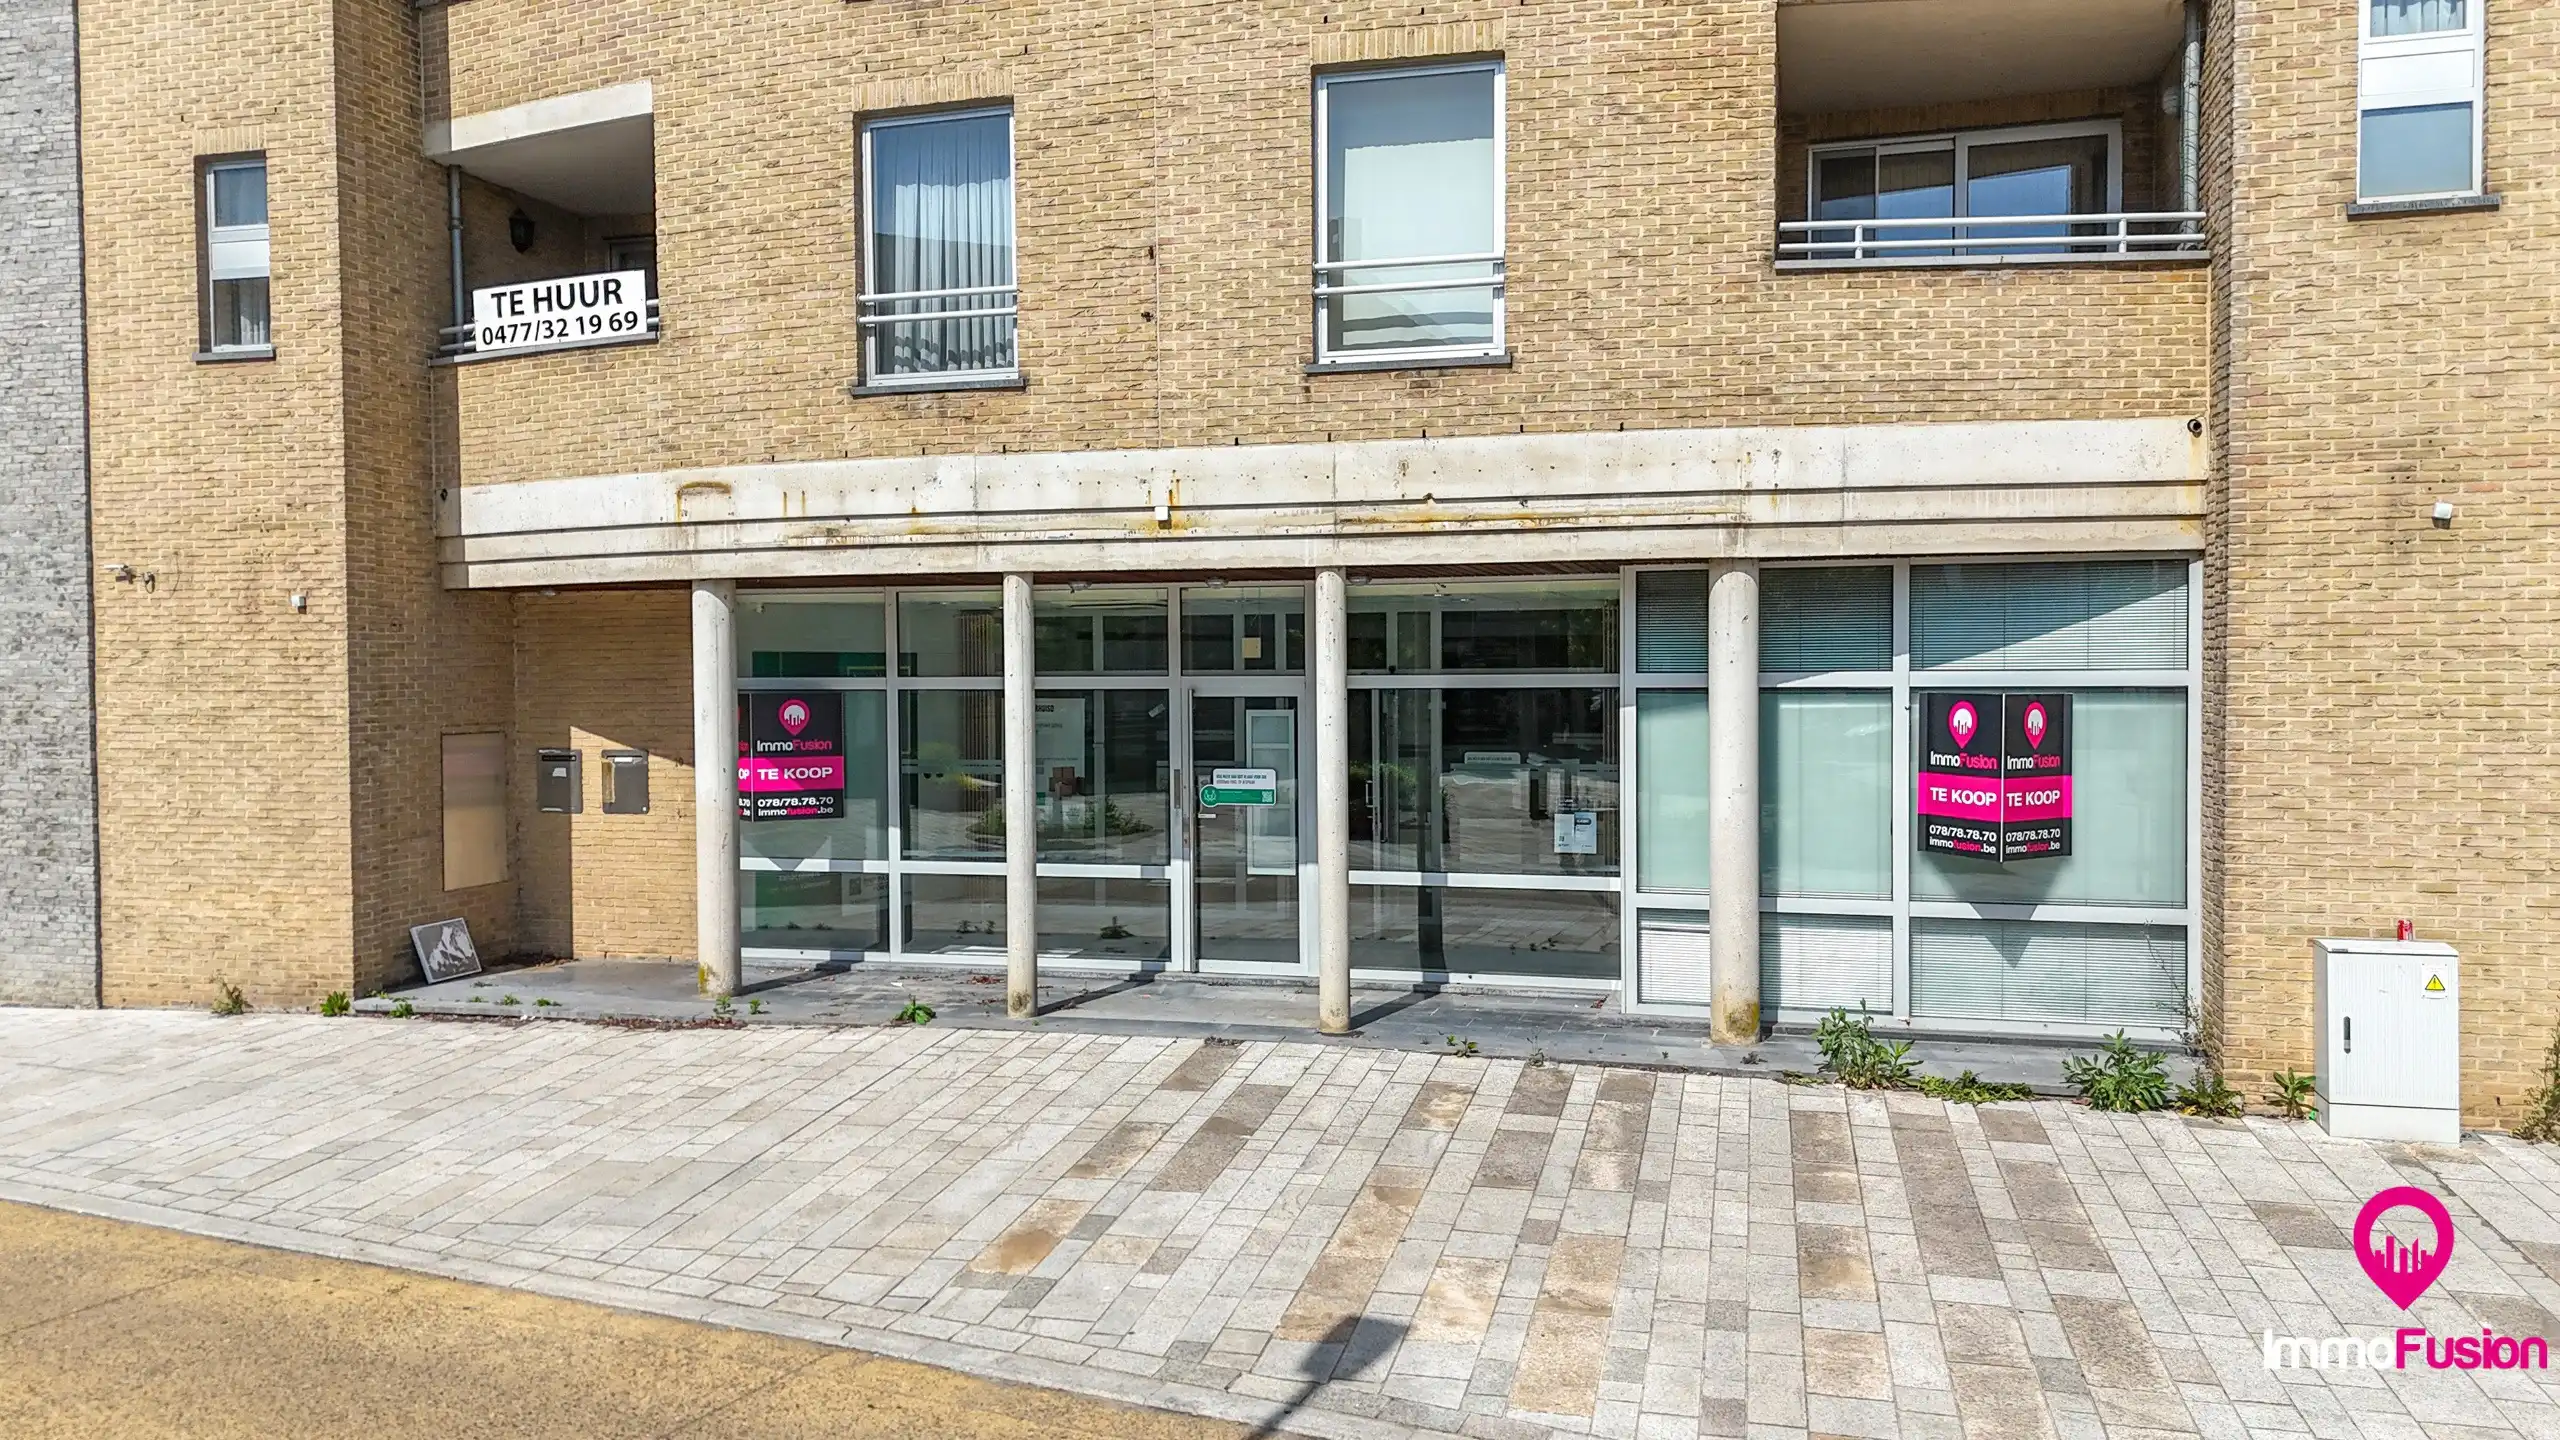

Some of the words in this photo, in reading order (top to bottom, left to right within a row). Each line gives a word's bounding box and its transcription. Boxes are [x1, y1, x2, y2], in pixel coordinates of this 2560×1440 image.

[491, 290, 524, 318] TE
[533, 279, 622, 314] HUUR
[482, 319, 569, 346] 0477/32
[575, 314, 602, 335] 19
[609, 310, 639, 332] 69
[756, 739, 832, 752] ImmoFusion
[1930, 751, 1998, 770] ImmoFusion
[2007, 754, 2061, 770] ImmoFusion
[757, 768, 779, 780] TE
[783, 767, 833, 779] KOOP
[757, 796, 834, 808] 078/78.78.70
[1930, 787, 1948, 802] TE
[1951, 789, 1997, 807] KOOP
[2006, 793, 2023, 807] TE
[2026, 790, 2061, 805] KOOP
[757, 806, 834, 817] immofusion.be
[1929, 825, 1997, 842] 078/78.78.70
[2005, 828, 2061, 843] 078/78.78.70
[1929, 836, 1997, 854] immofusion.be
[2005, 841, 2061, 855] immofusion.be
